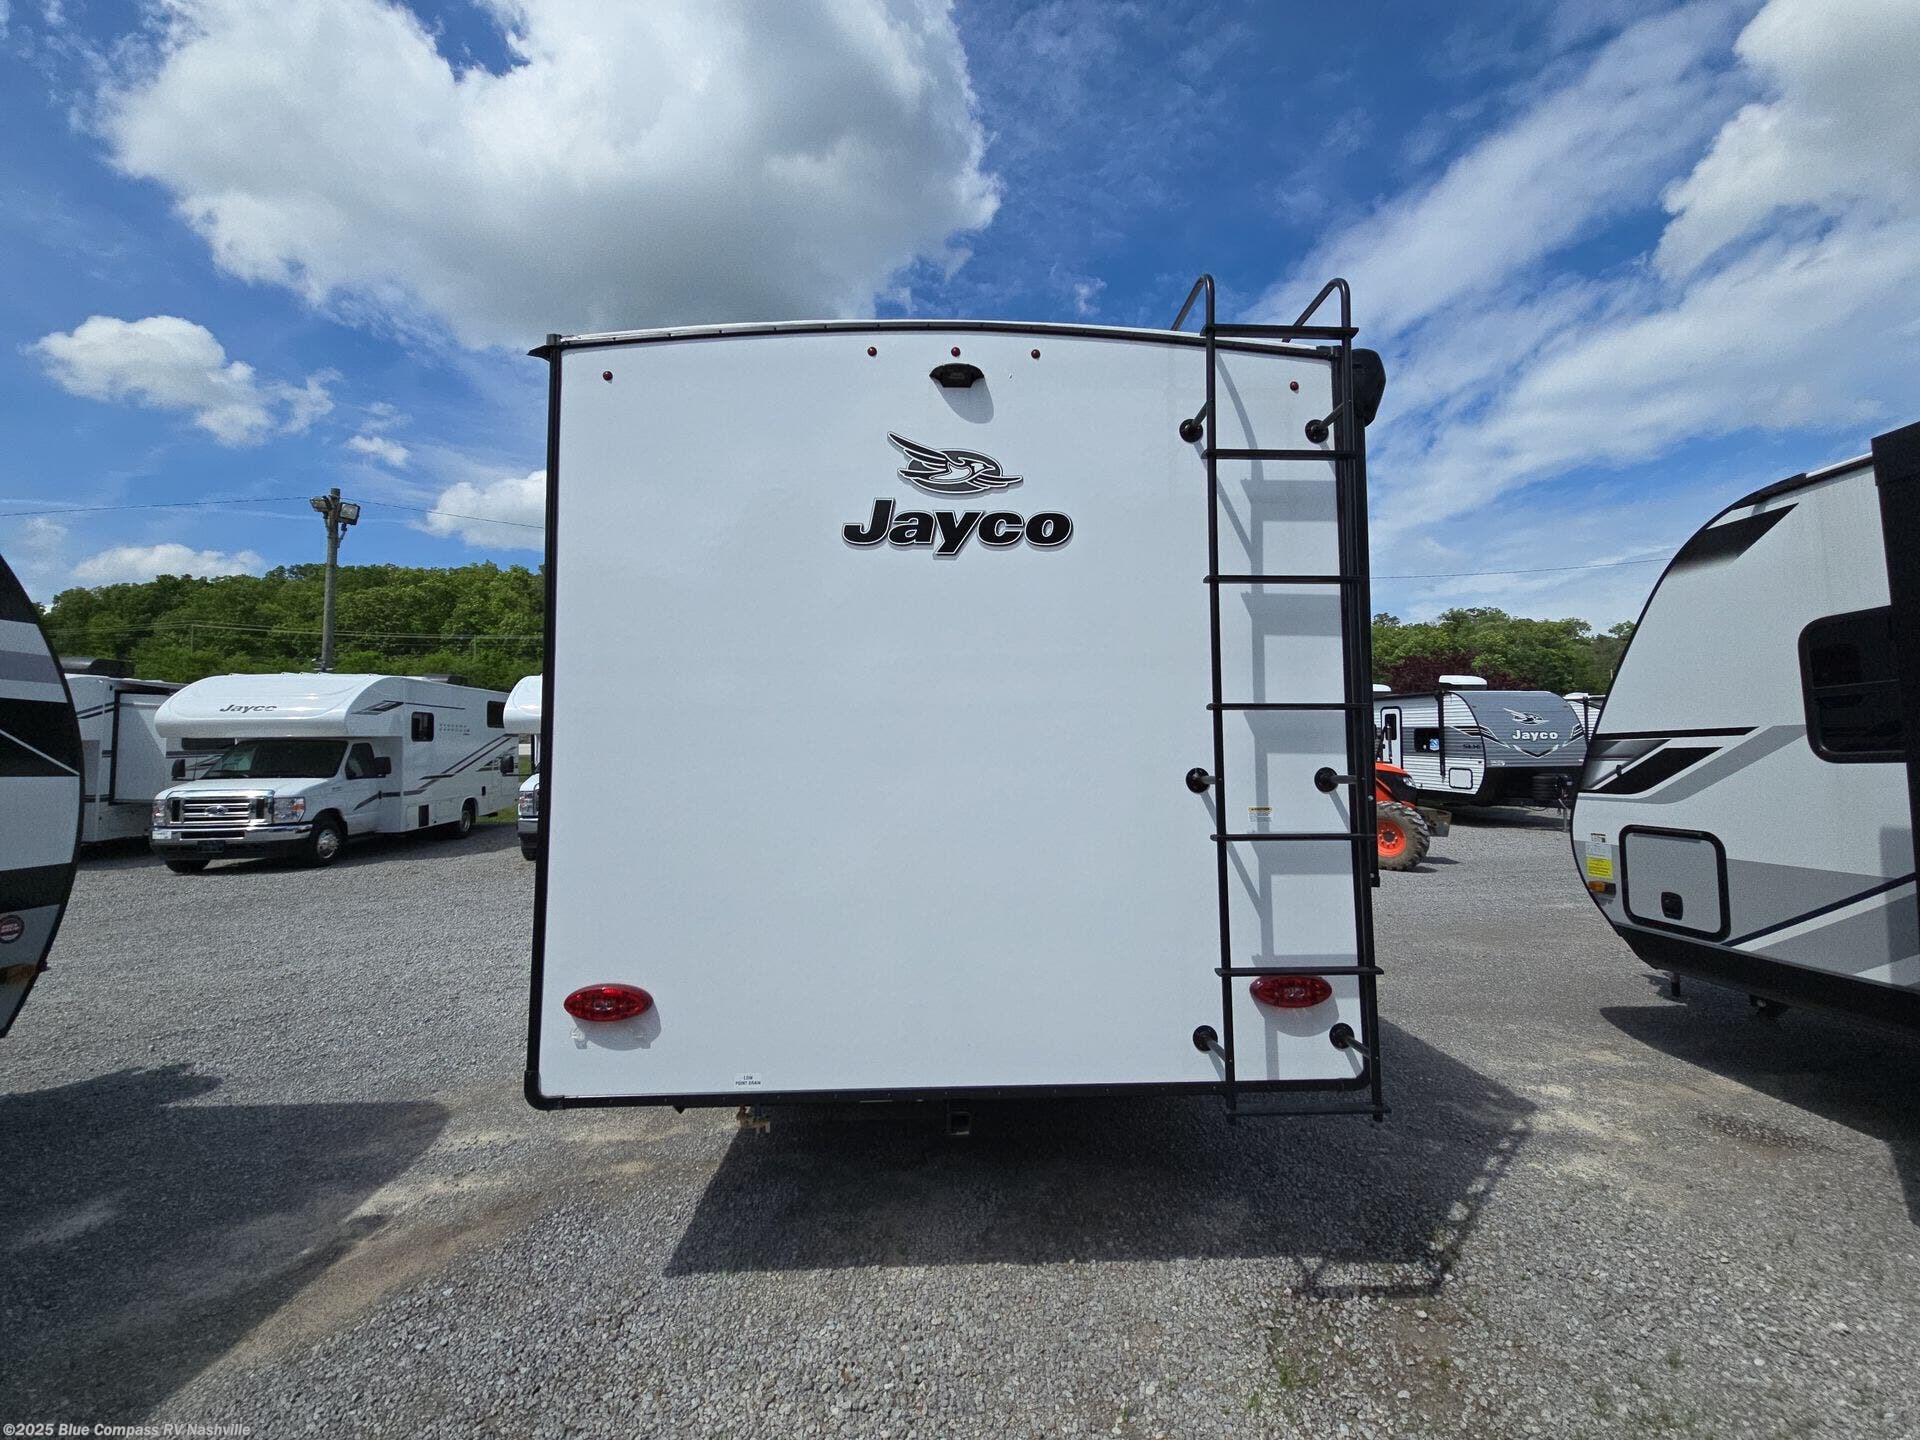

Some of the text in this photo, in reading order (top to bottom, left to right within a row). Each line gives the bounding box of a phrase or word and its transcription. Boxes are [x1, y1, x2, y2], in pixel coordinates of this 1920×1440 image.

[842, 497, 1073, 557] Jayco
[219, 704, 277, 713] Jayco
[1512, 730, 1558, 742] Jayco
